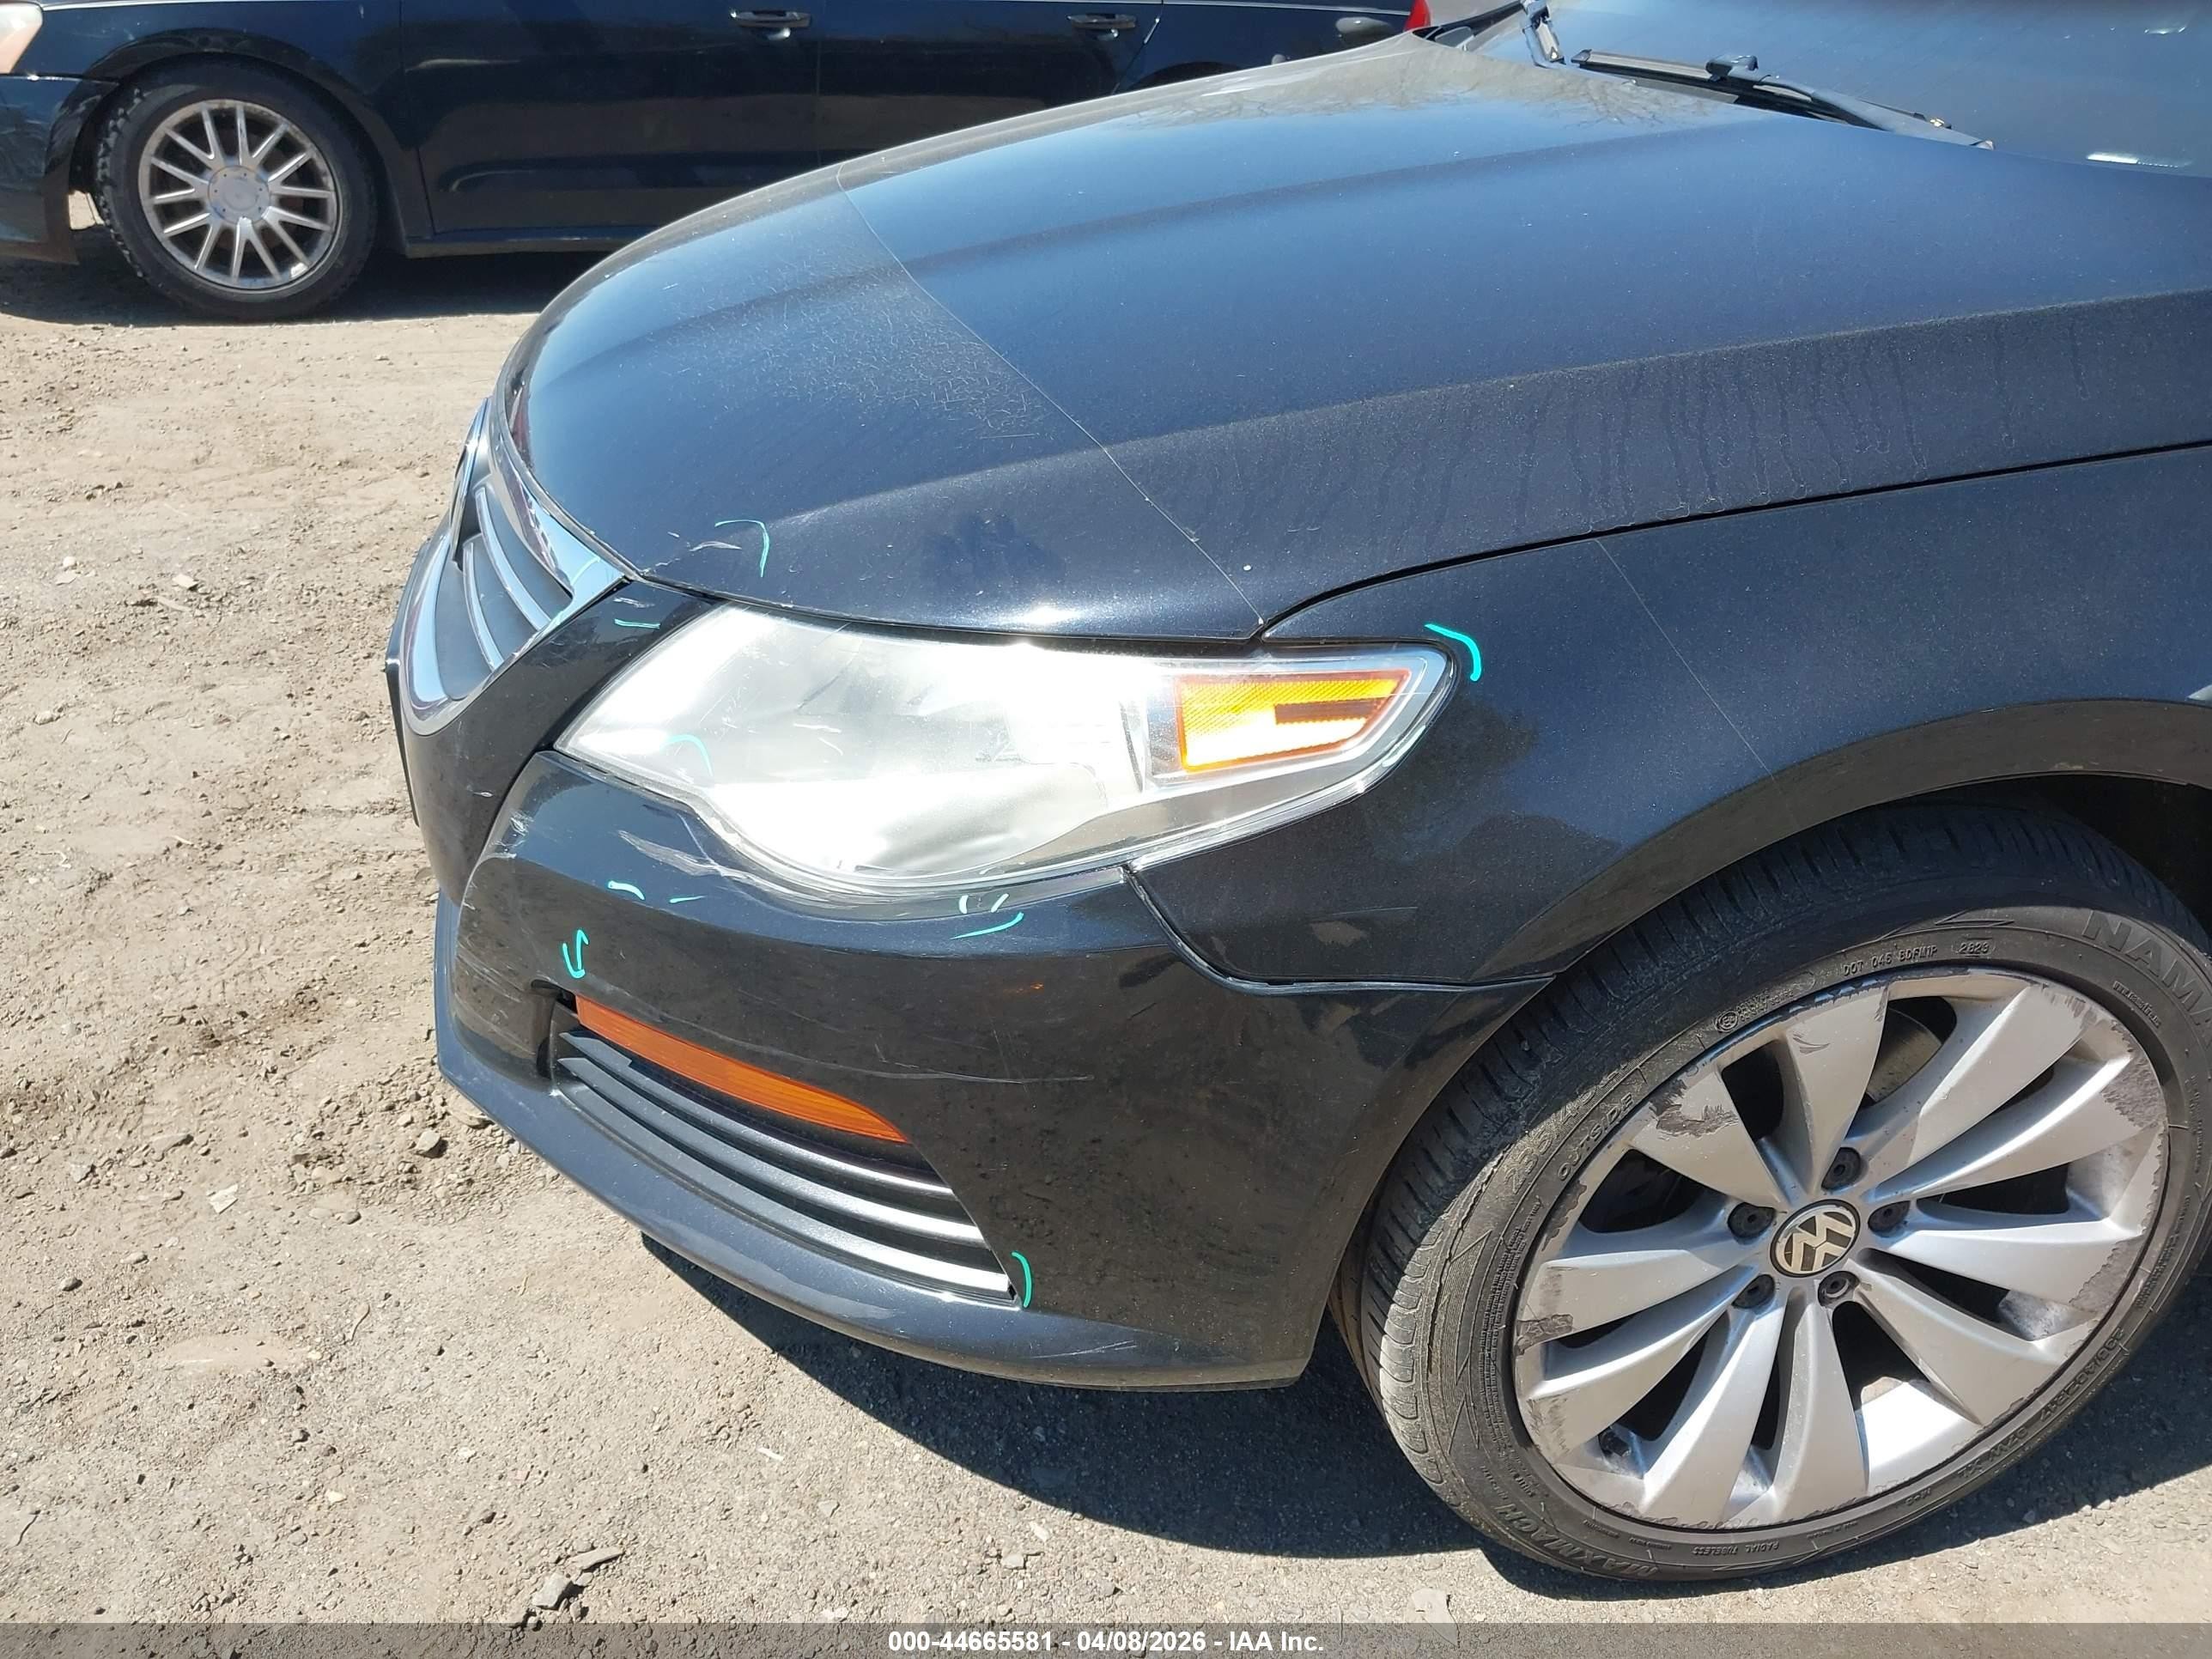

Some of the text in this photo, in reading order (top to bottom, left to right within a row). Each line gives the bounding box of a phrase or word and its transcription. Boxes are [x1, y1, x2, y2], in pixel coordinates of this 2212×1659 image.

[1844, 960, 1864, 976] DOT
[1558, 1092, 1634, 1181] OUTSIDE
[1494, 1503, 1661, 1578] MAXMACH
[1692, 1546, 1739, 1559] TUBELESS
